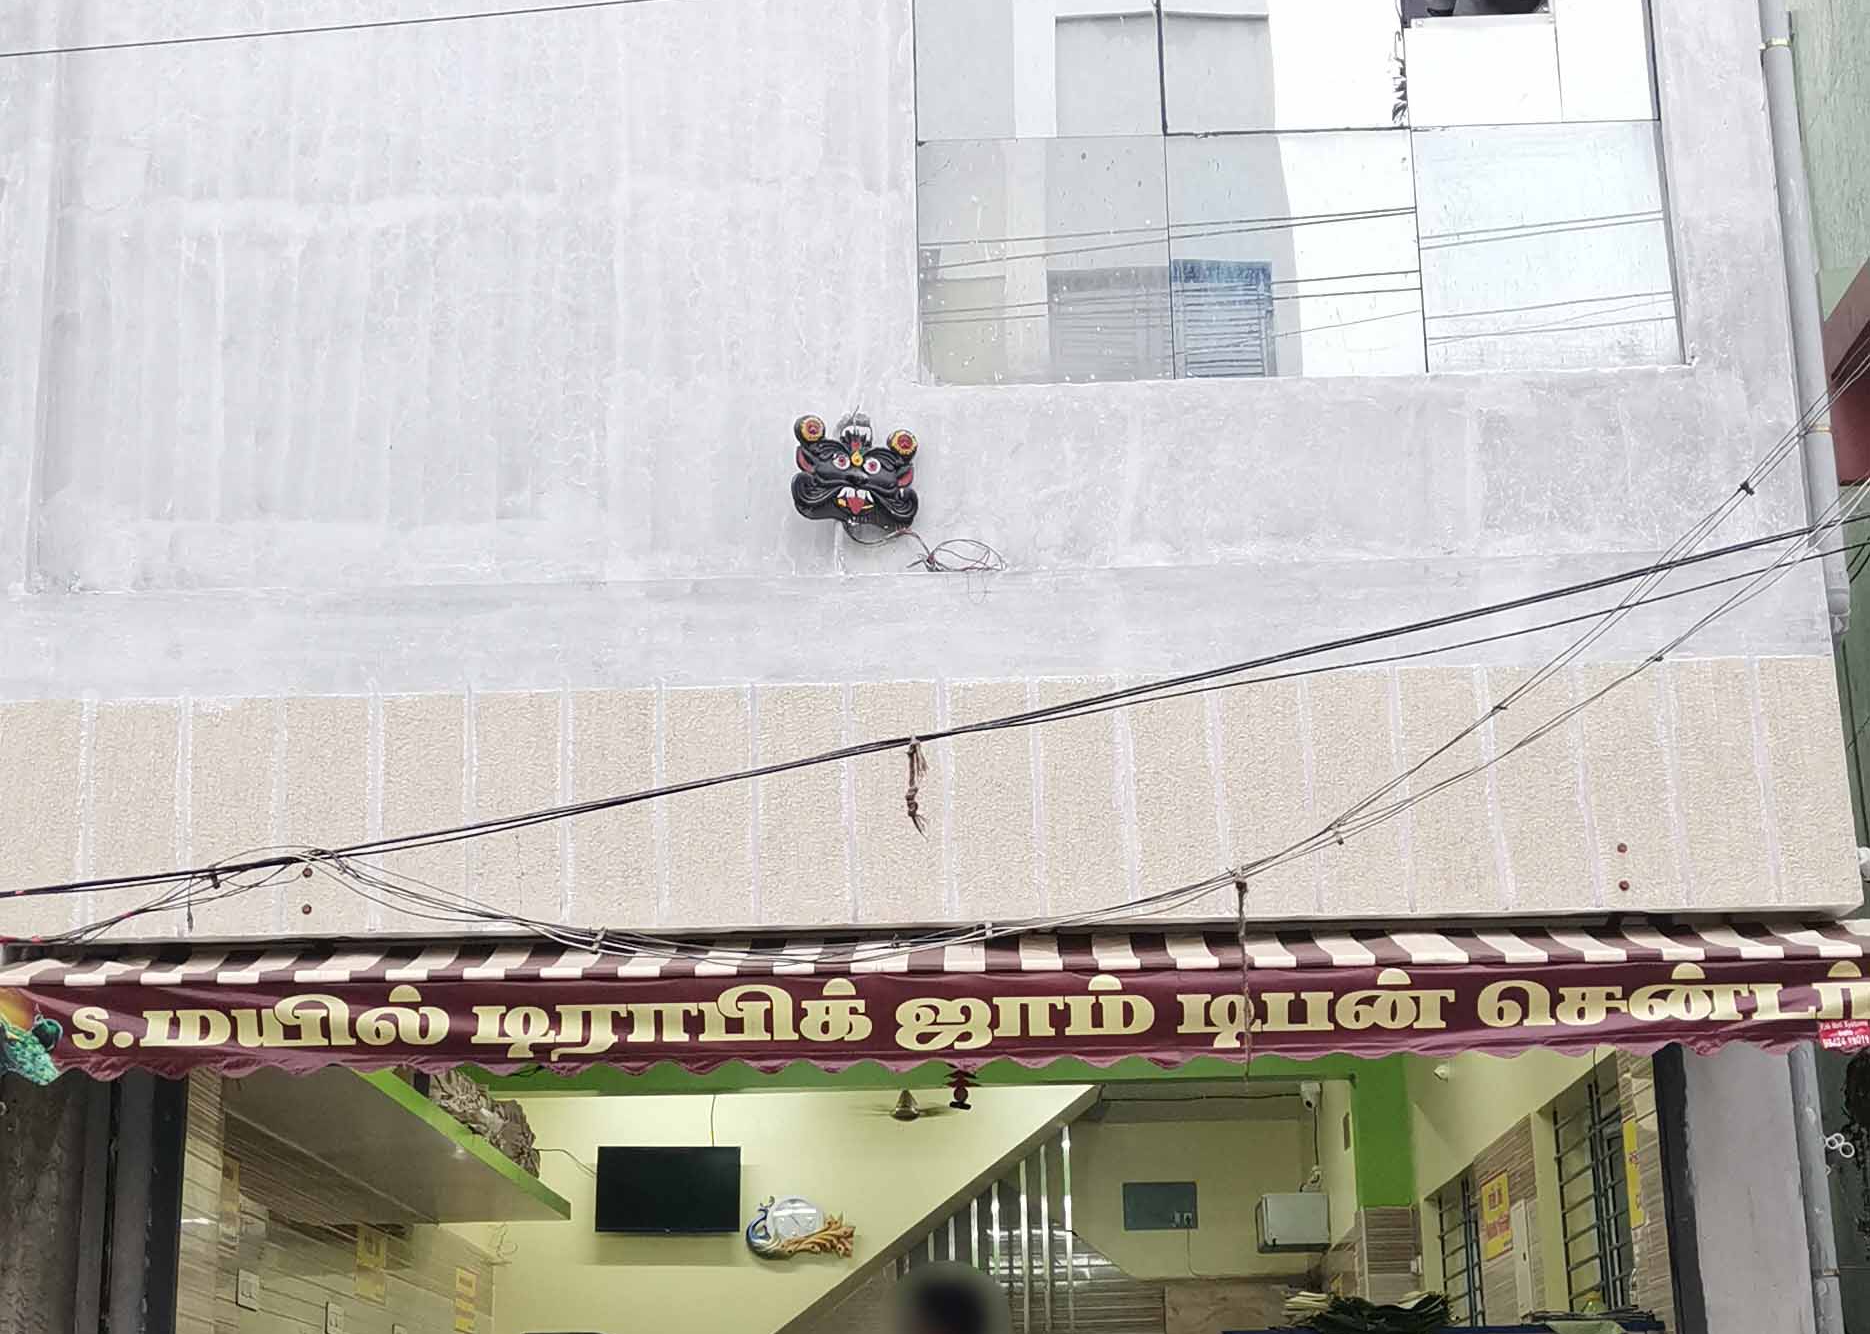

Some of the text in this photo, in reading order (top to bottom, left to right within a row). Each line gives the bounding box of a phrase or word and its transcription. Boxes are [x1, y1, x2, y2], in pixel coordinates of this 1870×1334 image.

[470, 977, 873, 1061] டிராபிக்
[895, 974, 1155, 1051] ஜாம்
[1177, 968, 1455, 1048] டிபன்
[1477, 960, 1870, 1027] சென்டர்
